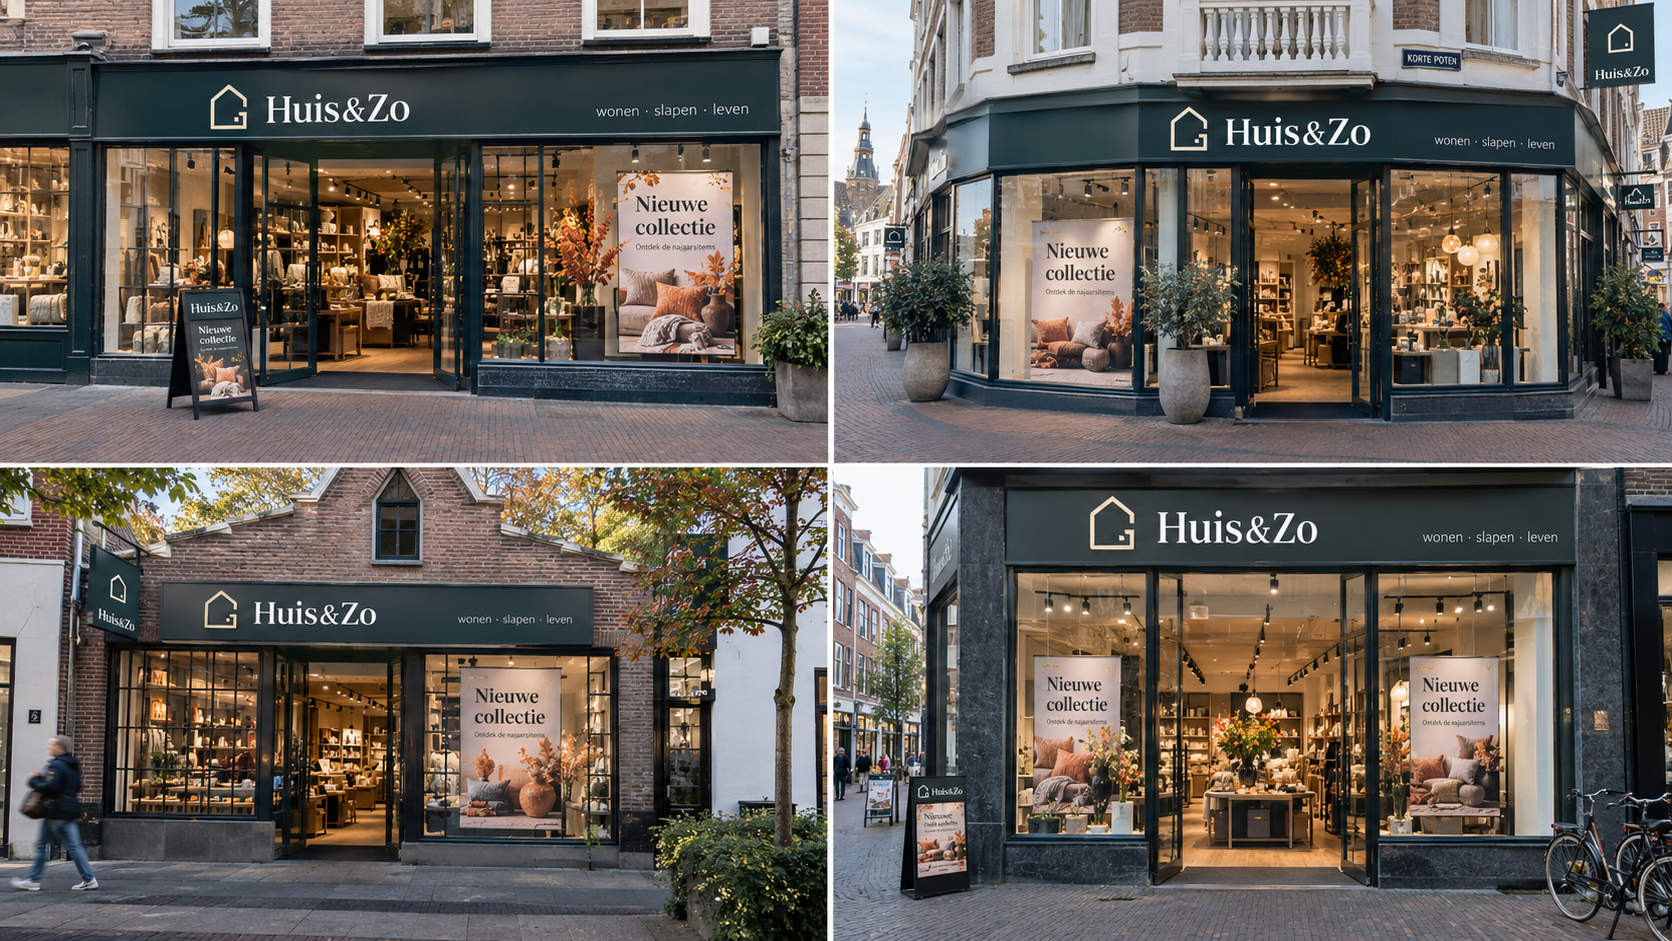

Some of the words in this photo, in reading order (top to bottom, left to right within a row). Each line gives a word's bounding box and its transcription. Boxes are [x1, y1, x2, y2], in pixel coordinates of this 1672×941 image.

[1407, 54, 1431, 64] KORTE
[1434, 55, 1457, 65] POTEN
[1595, 66, 1649, 80] Huis&Zo
[266, 93, 410, 124] Huis&Zo
[596, 107, 640, 117] wonen
[654, 104, 697, 118] slapen
[713, 103, 749, 115] leven
[1225, 117, 1371, 146] Huis&Zo
[1434, 137, 1471, 146] wonen
[1482, 136, 1516, 150] slapen
[1527, 138, 1555, 150] leven
[635, 195, 708, 212] Nieuwe
[635, 218, 716, 235] collectie
[635, 243, 660, 251] Ontdek
[662, 243, 671, 251] de
[1046, 242, 1109, 259] Nieuwe
[1046, 264, 1116, 281] collectie
[190, 302, 239, 314] Huis&Zo
[198, 325, 232, 335] Nieuwe
[199, 335, 237, 345] collectie
[1157, 510, 1318, 544] Huis&Zo
[1423, 533, 1463, 543] wonen
[1476, 530, 1515, 545] slapen
[1527, 531, 1558, 543] leven
[98, 608, 135, 632] Huis&Zo
[254, 600, 377, 626] Huis&Zo
[458, 616, 492, 624] wonen
[502, 614, 536, 626] slapen
[546, 614, 573, 624] leven
[1047, 676, 1102, 692] Nieuwe
[1422, 677, 1479, 692] Nieuwe
[474, 688, 539, 703] Nieuwe
[1046, 696, 1108, 712] collectie
[1422, 697, 1485, 713] collectie
[474, 708, 546, 724] collectie
